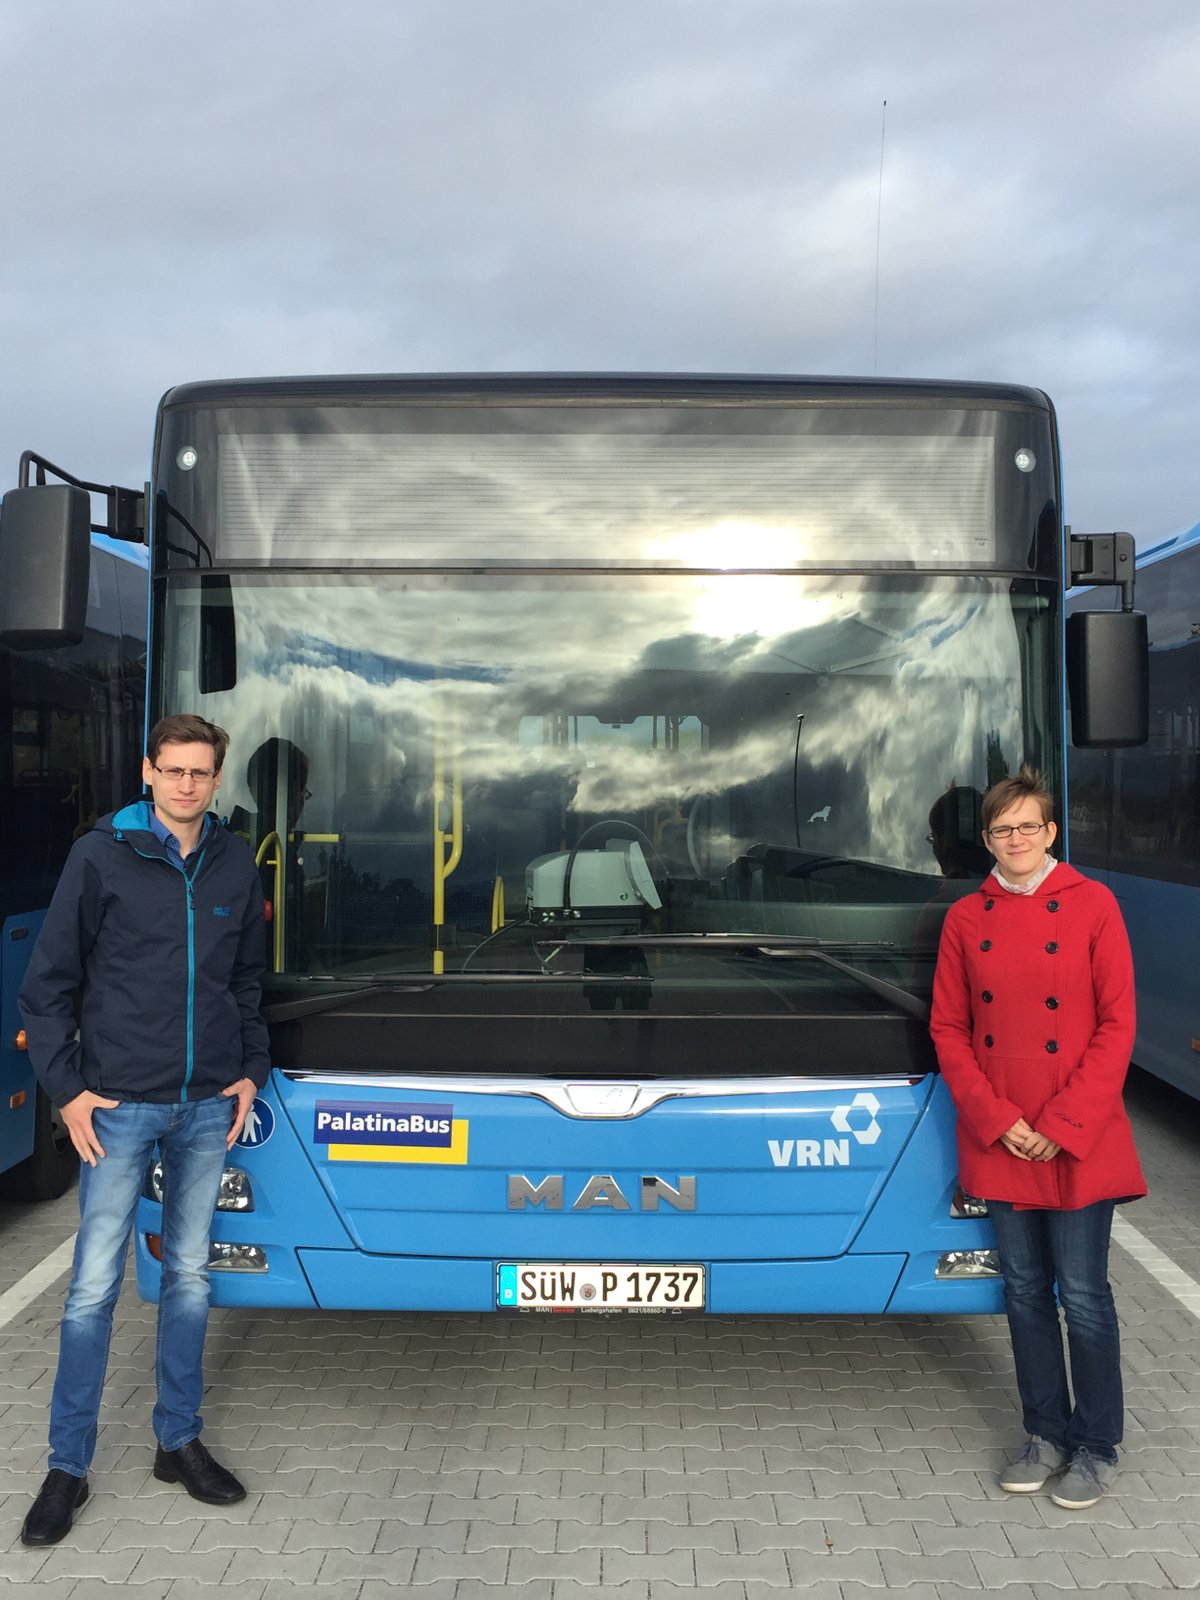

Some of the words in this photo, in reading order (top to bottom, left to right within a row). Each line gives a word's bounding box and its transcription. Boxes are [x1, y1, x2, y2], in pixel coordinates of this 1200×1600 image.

[317, 1112, 450, 1134] PalatinaBus
[768, 1139, 850, 1167] VRN
[507, 1174, 697, 1211] MAN
[521, 1271, 576, 1301] SÜW
[601, 1272, 618, 1302] P
[626, 1272, 699, 1302] 1737
[580, 1307, 622, 1315] Ludwigshafen
